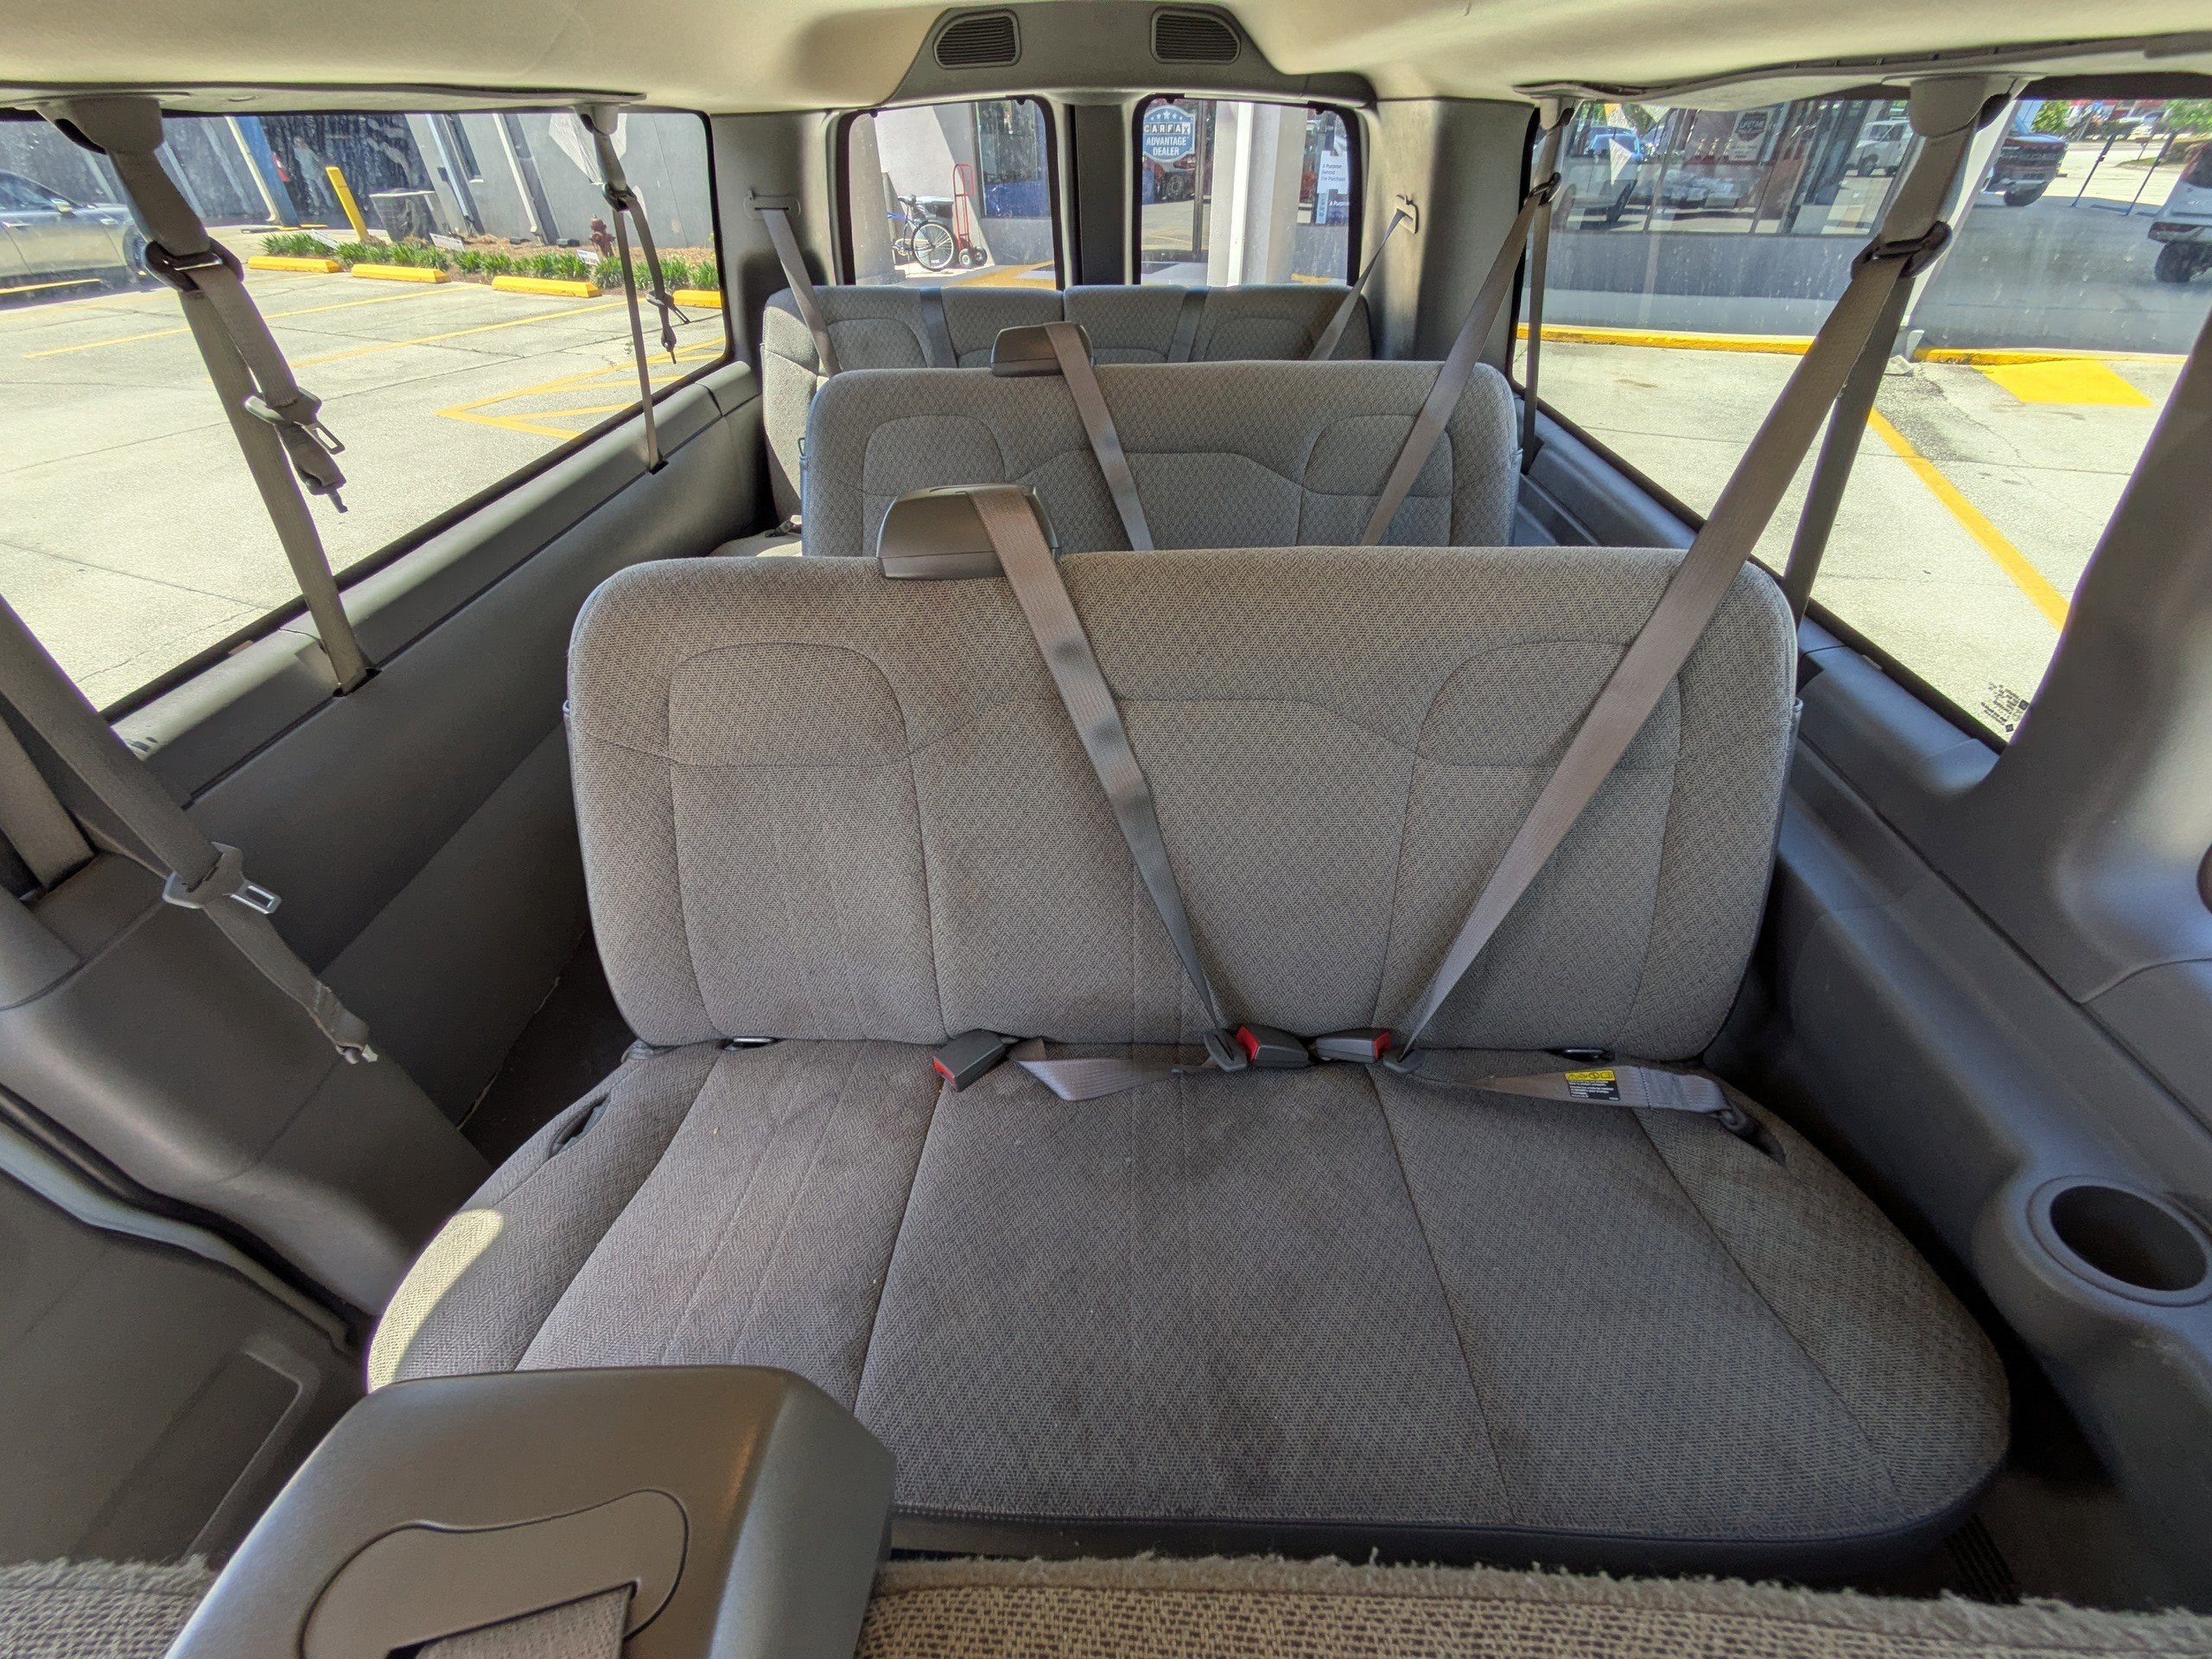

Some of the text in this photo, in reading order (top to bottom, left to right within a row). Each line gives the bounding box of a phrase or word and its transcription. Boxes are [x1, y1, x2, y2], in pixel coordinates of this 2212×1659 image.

[1143, 124, 1191, 134] CARFAX
[1146, 137, 1187, 146] ADVANTAGE
[1153, 146, 1180, 156] DEALER
